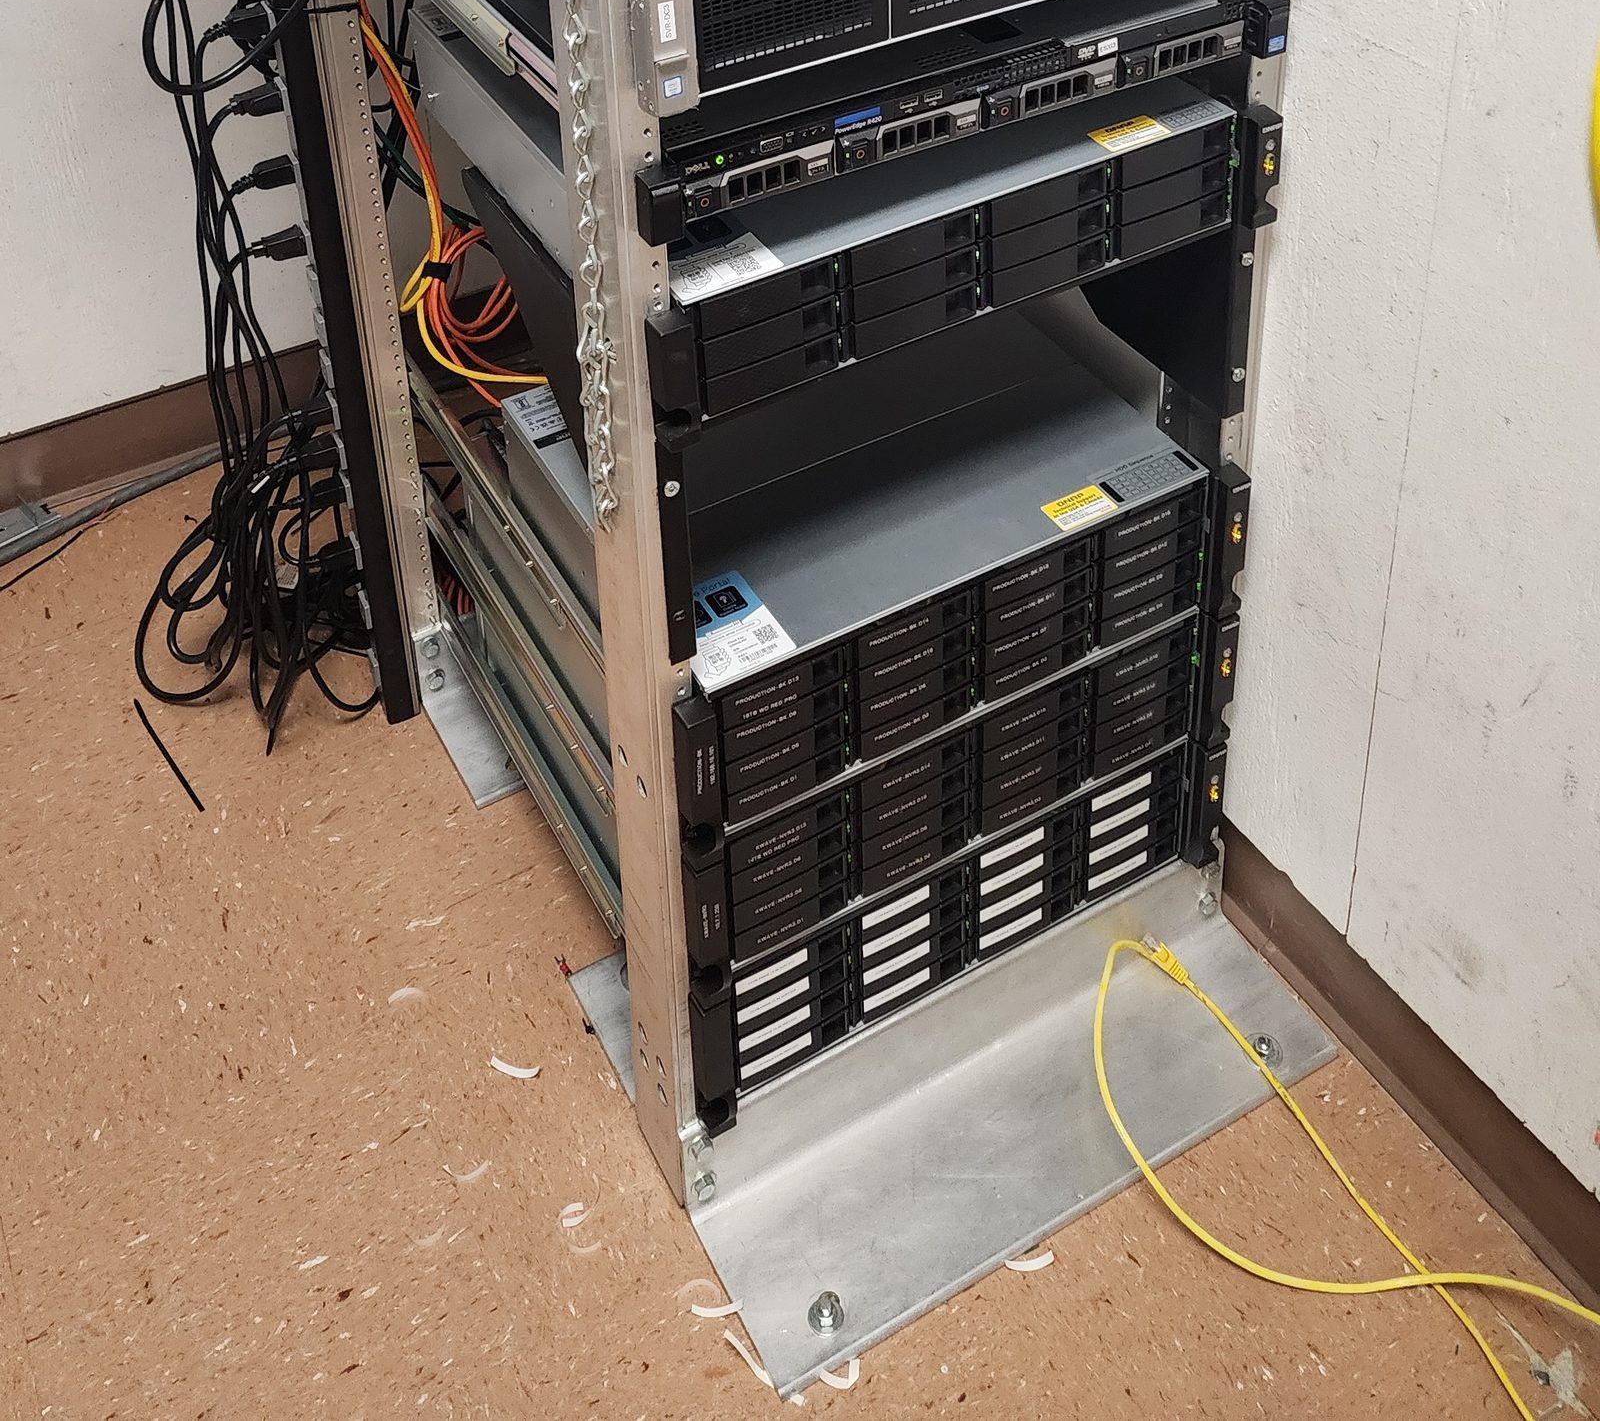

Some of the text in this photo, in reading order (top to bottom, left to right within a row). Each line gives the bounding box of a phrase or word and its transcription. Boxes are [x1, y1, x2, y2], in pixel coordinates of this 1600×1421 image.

[664, 4, 673, 39] SVR-DC3
[1078, 45, 1096, 55] DVD
[834, 115, 883, 134] PowerEdge R420
[1104, 121, 1135, 133] QNAP
[685, 161, 711, 176] DELL
[702, 577, 730, 594] Portal
